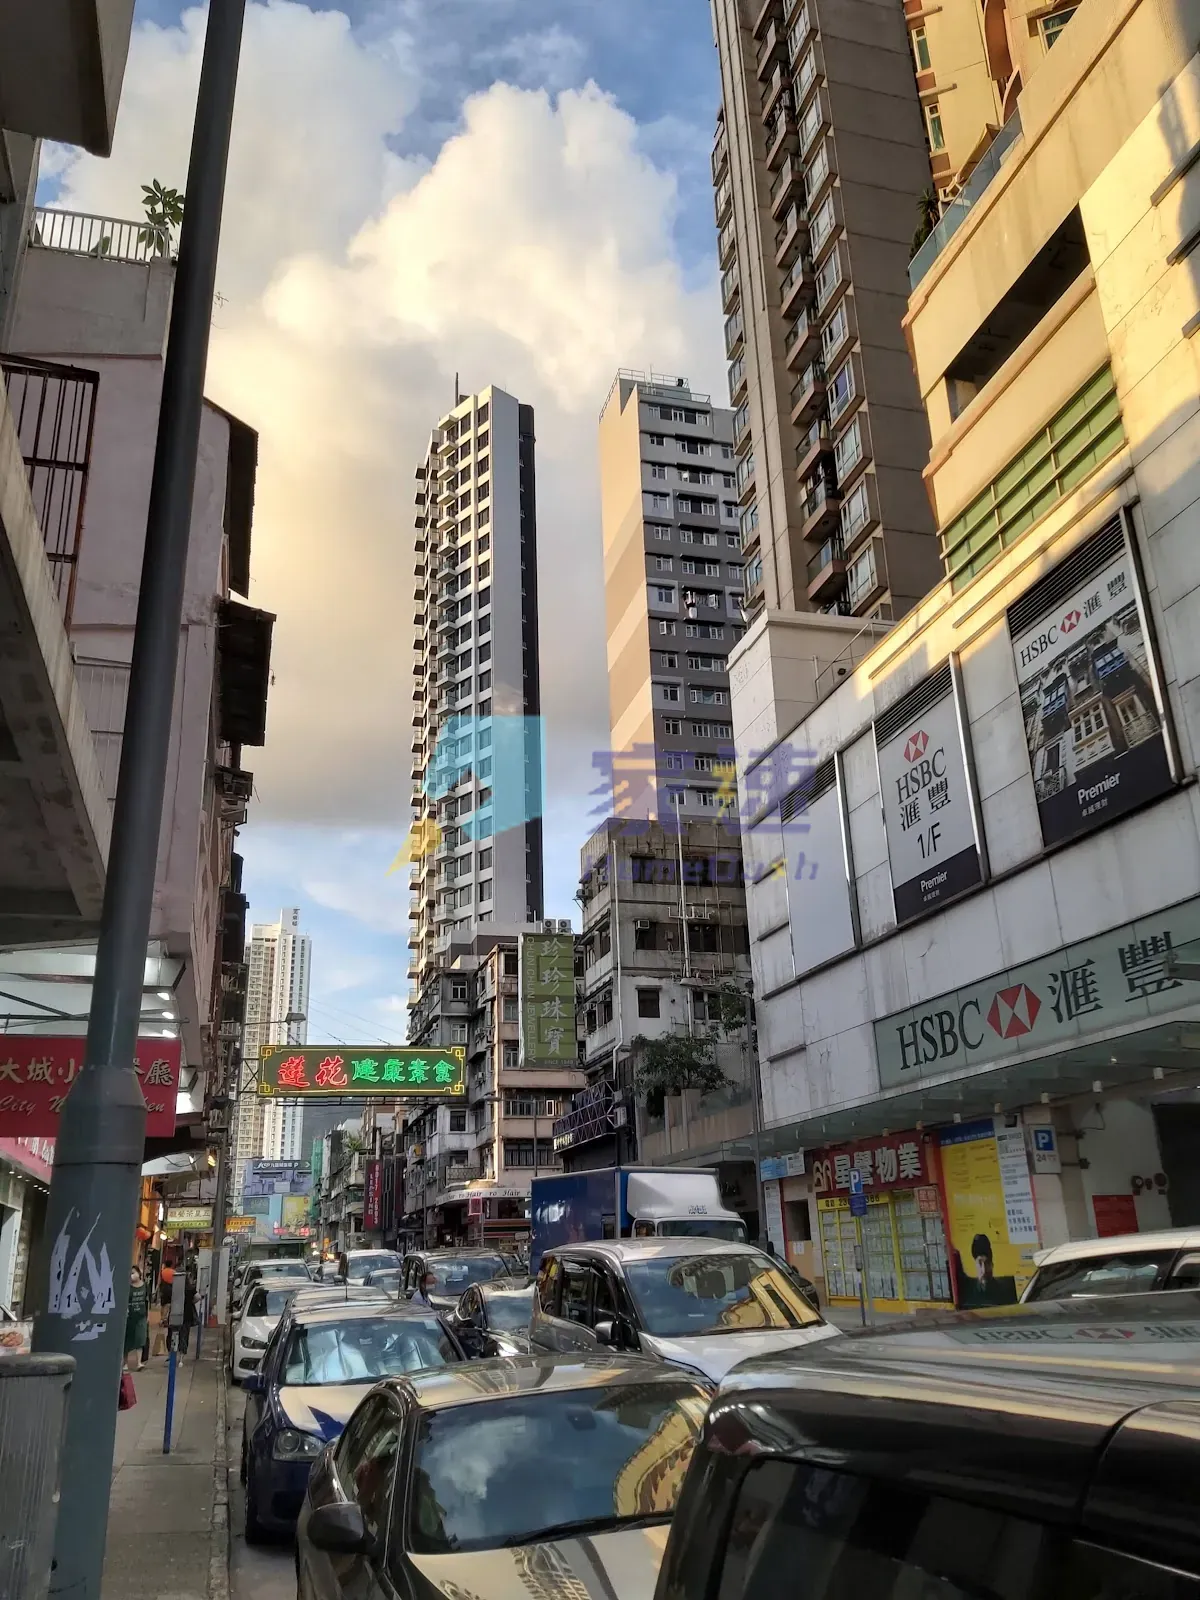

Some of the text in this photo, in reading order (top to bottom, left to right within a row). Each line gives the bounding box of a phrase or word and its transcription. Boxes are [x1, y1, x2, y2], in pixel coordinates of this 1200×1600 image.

[1020, 625, 1059, 668] HSBC
[895, 746, 947, 805] HSBC
[1077, 772, 1120, 805] Premier
[916, 821, 942, 859] 1/F
[920, 870, 948, 893] Premier
[526, 936, 536, 1063] CHUN CHUN JEWELLERY
[540, 937, 568, 1056] 珍珍珠寶
[896, 998, 984, 1070] HSBC
